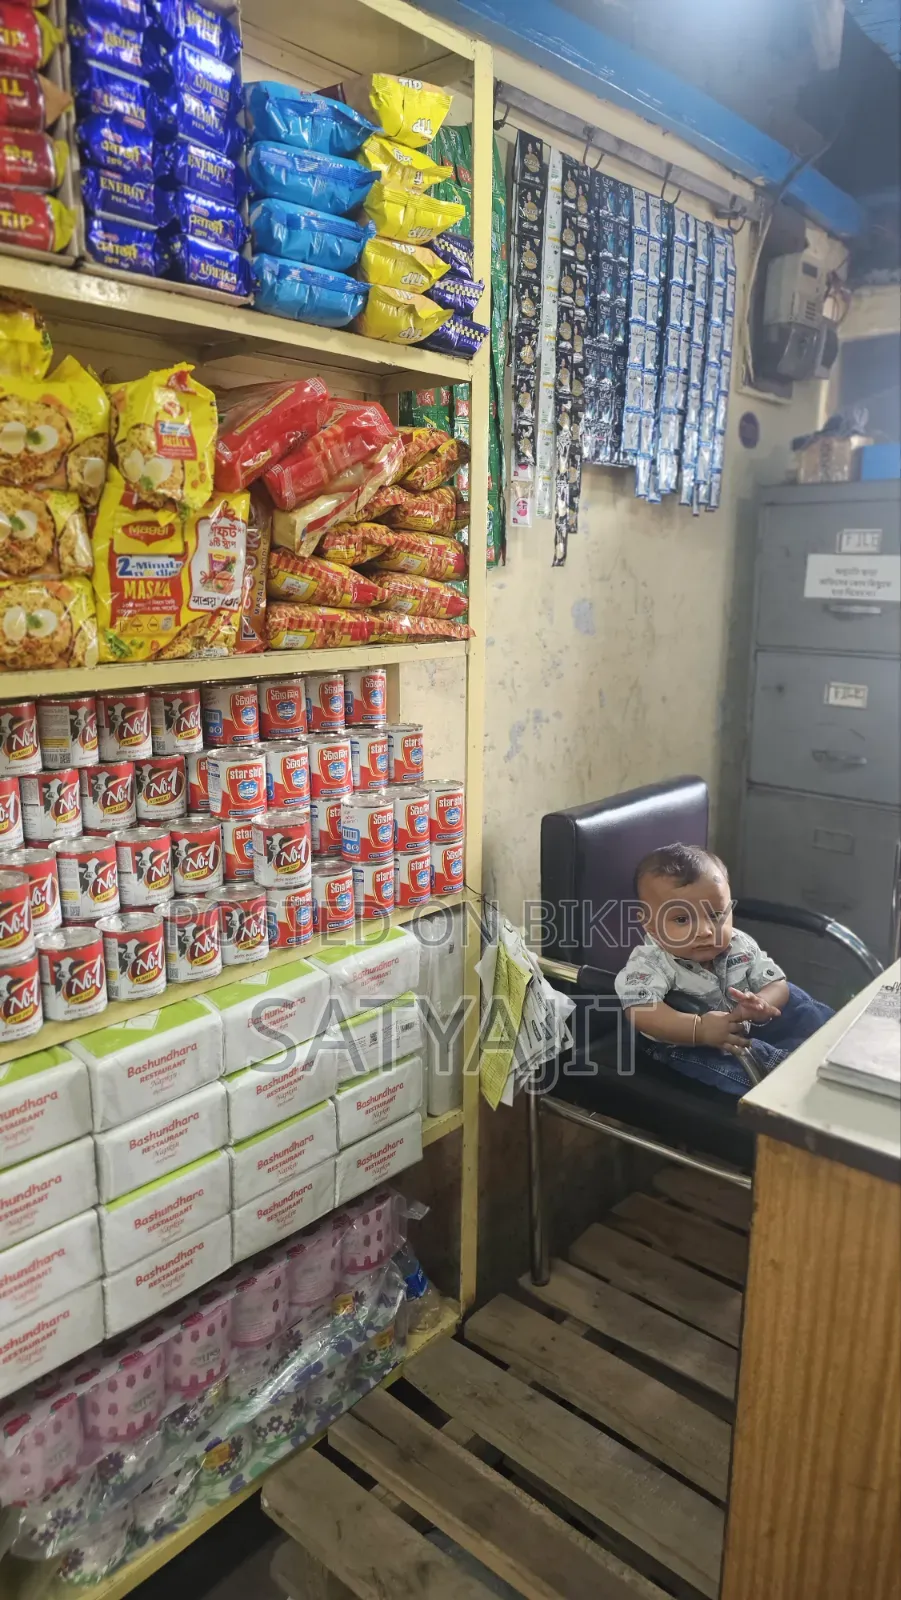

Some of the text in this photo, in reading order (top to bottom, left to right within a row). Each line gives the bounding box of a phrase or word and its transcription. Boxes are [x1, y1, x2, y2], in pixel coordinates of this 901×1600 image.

[188, 153, 227, 179] ENERGY
[100, 176, 145, 200] ENERGY
[129, 525, 169, 537] Maggi
[254, 580, 265, 616] MASALA
[12, 715, 38, 751] No.1
[123, 707, 148, 738] No.1
[404, 737, 417, 748] star
[106, 773, 133, 806] No.1
[149, 767, 178, 798] No.1
[230, 769, 248, 780] star
[0, 790, 16, 825] o.1
[59, 780, 81, 815] No.1
[187, 840, 216, 873] No.1
[280, 834, 306, 867] No.1
[411, 861, 425, 871] star
[195, 920, 218, 957] No.1
[239, 910, 265, 942] No.1
[136, 937, 163, 976] No.1
[72, 954, 102, 995] No.1
[9, 972, 39, 1015] No.1
[127, 1042, 198, 1079] Bashundhara
[140, 1058, 188, 1085] RESTAURANT
[256, 1059, 315, 1096] Bashundhara
[267, 1074, 305, 1099] RESTAURANT
[356, 1082, 404, 1111] Bashundhara
[365, 1095, 397, 1116] RESTAURANT
[129, 1111, 200, 1150] Bashundhara
[141, 1128, 189, 1155] RESTAURANT
[257, 1134, 315, 1170] Bashundhara
[267, 1149, 306, 1174] RESTAURANT
[356, 1137, 404, 1168] Bashundhara
[364, 1151, 397, 1172] RESTAURANT
[0, 1174, 63, 1209] hundhara
[256, 1182, 313, 1220] Bashundhara
[133, 1188, 205, 1230] Bashundhara
[147, 1204, 194, 1233] RESTAURANT
[267, 1197, 304, 1223] RESTAURANT
[0, 1248, 66, 1287] shundhara
[135, 1241, 205, 1287] Bashundhara
[148, 1258, 194, 1289] RESTAURANT
